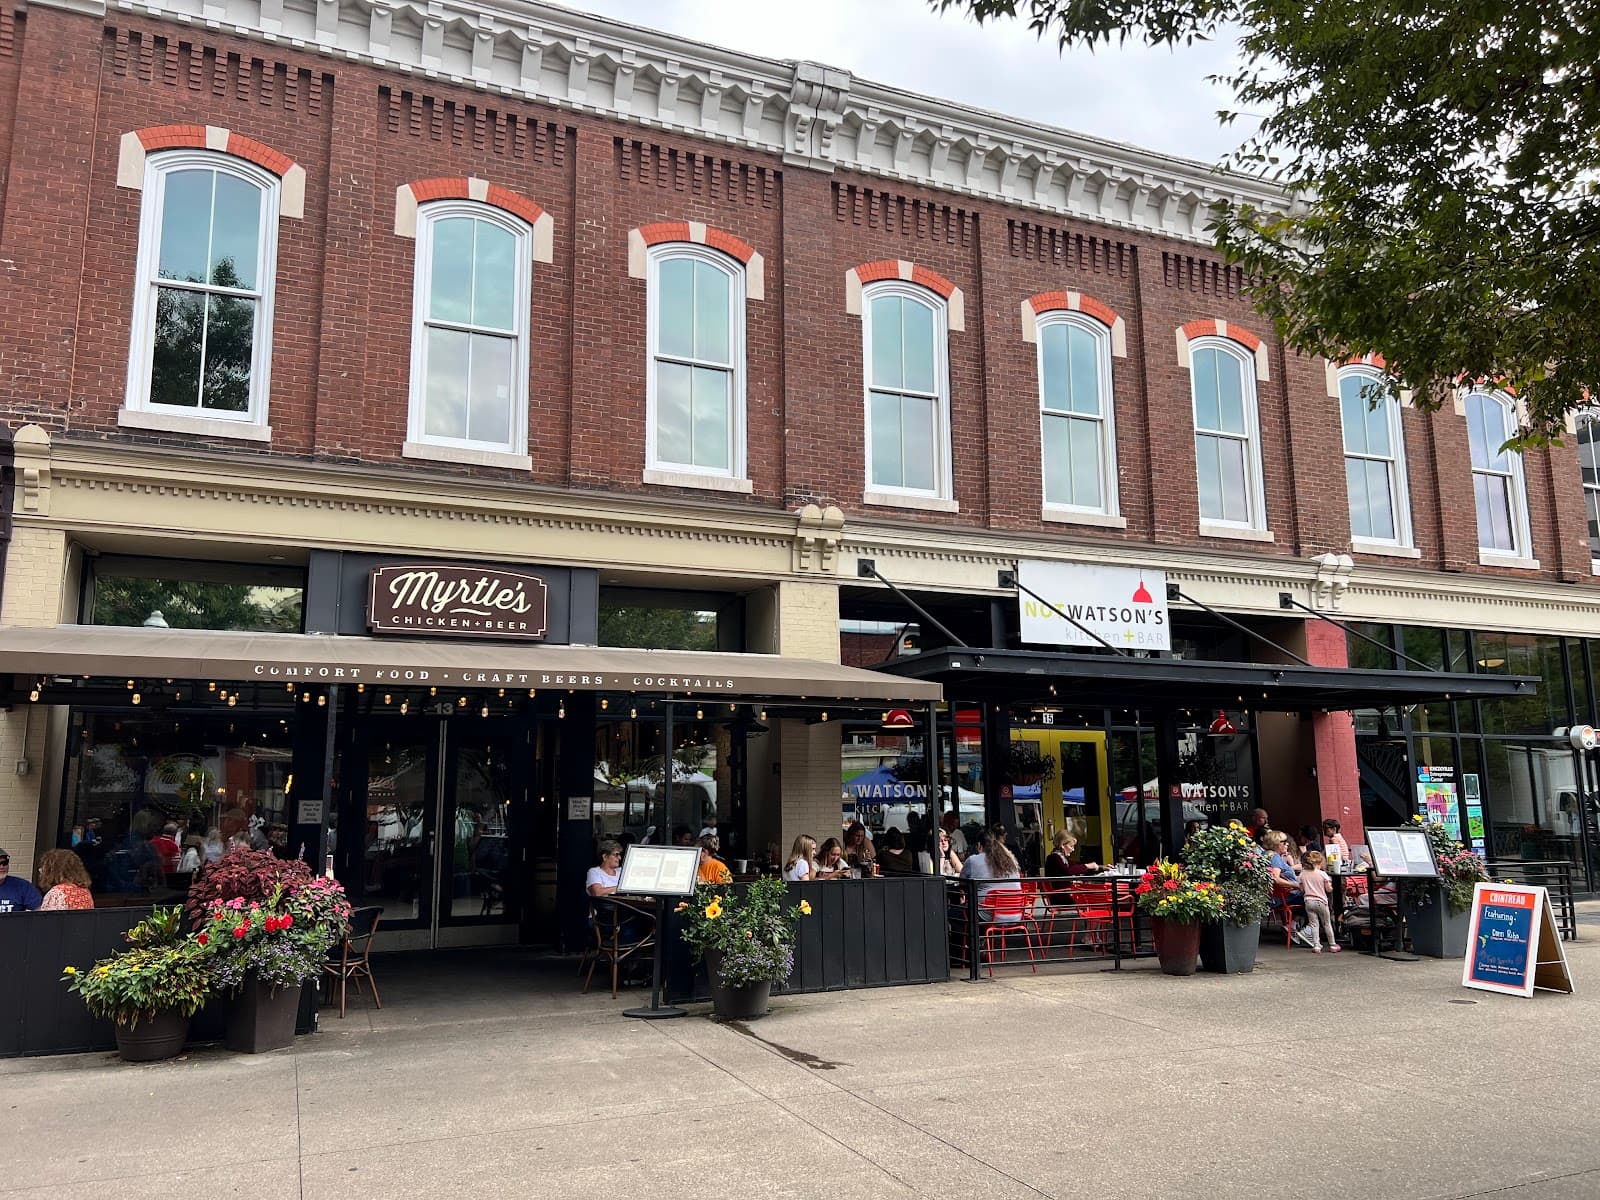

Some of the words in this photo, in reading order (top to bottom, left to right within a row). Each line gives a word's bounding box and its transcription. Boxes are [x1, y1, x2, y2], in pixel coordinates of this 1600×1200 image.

[389, 571, 532, 614] Myrtle's
[254, 665, 361, 678] COMFORT
[375, 669, 430, 681] FOOD
[462, 671, 529, 684] CRAFT
[541, 673, 604, 686] BEERS
[632, 676, 735, 689] COCKTAILS
[433, 702, 454, 715] 13
[1043, 713, 1053, 724] 15
